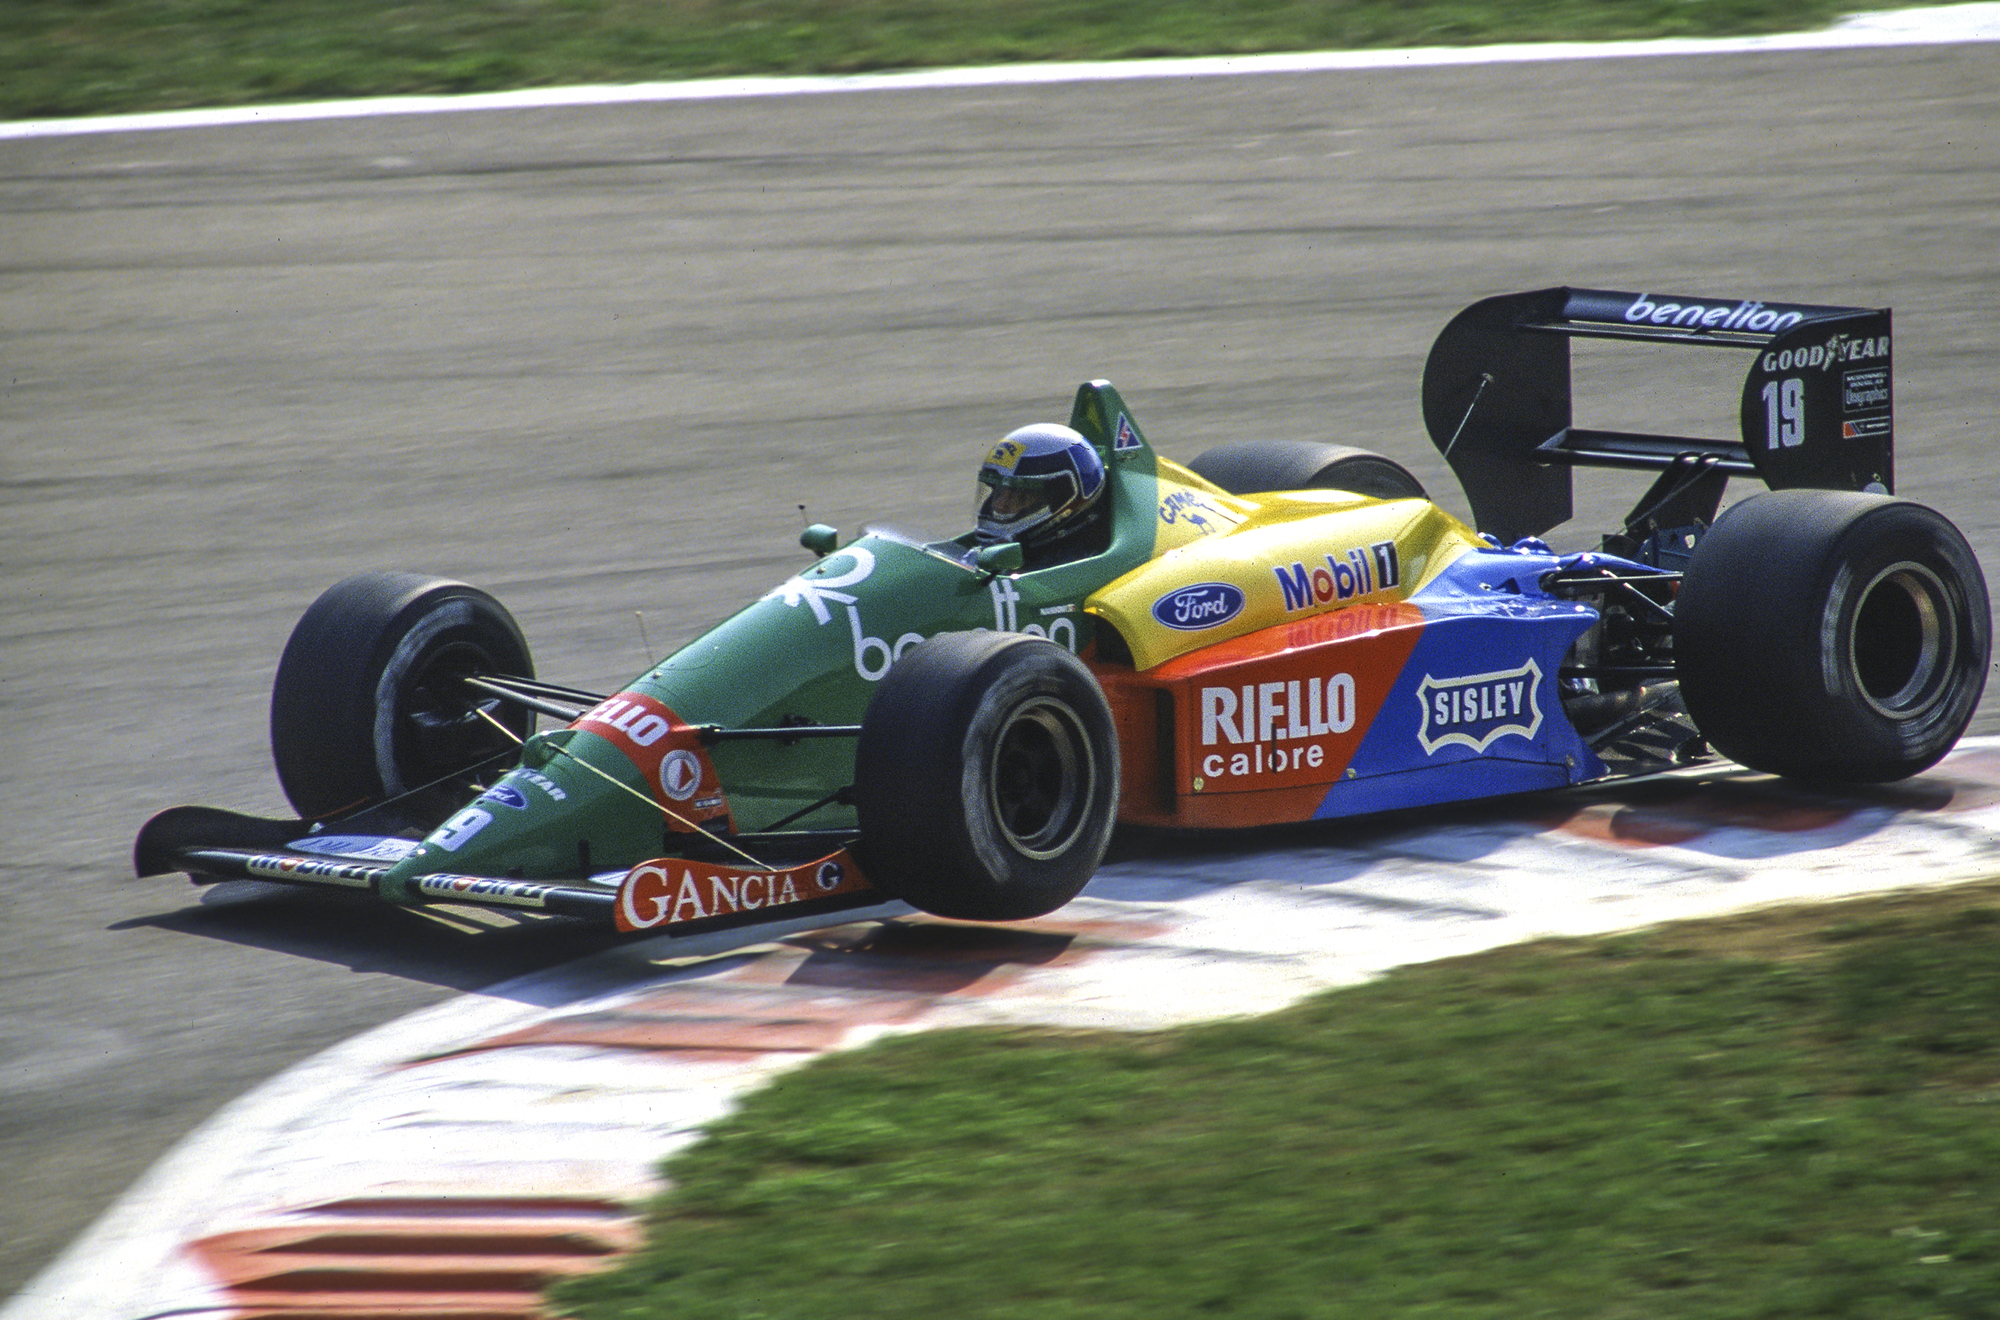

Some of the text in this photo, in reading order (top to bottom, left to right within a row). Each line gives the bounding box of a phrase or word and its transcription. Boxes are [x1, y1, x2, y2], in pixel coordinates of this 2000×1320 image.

[1624, 293, 1803, 331] benetton
[1762, 334, 1890, 372] GOODYEAR
[1762, 378, 1805, 450] 19
[1273, 544, 1395, 612] Mobil 1
[1174, 589, 1229, 623] Ford
[580, 698, 671, 747] ELLO
[1201, 672, 1357, 746] RIELLO
[1435, 681, 1525, 725] SISLEY
[1202, 743, 1325, 778] calore
[622, 861, 842, 929] GANCIA G
